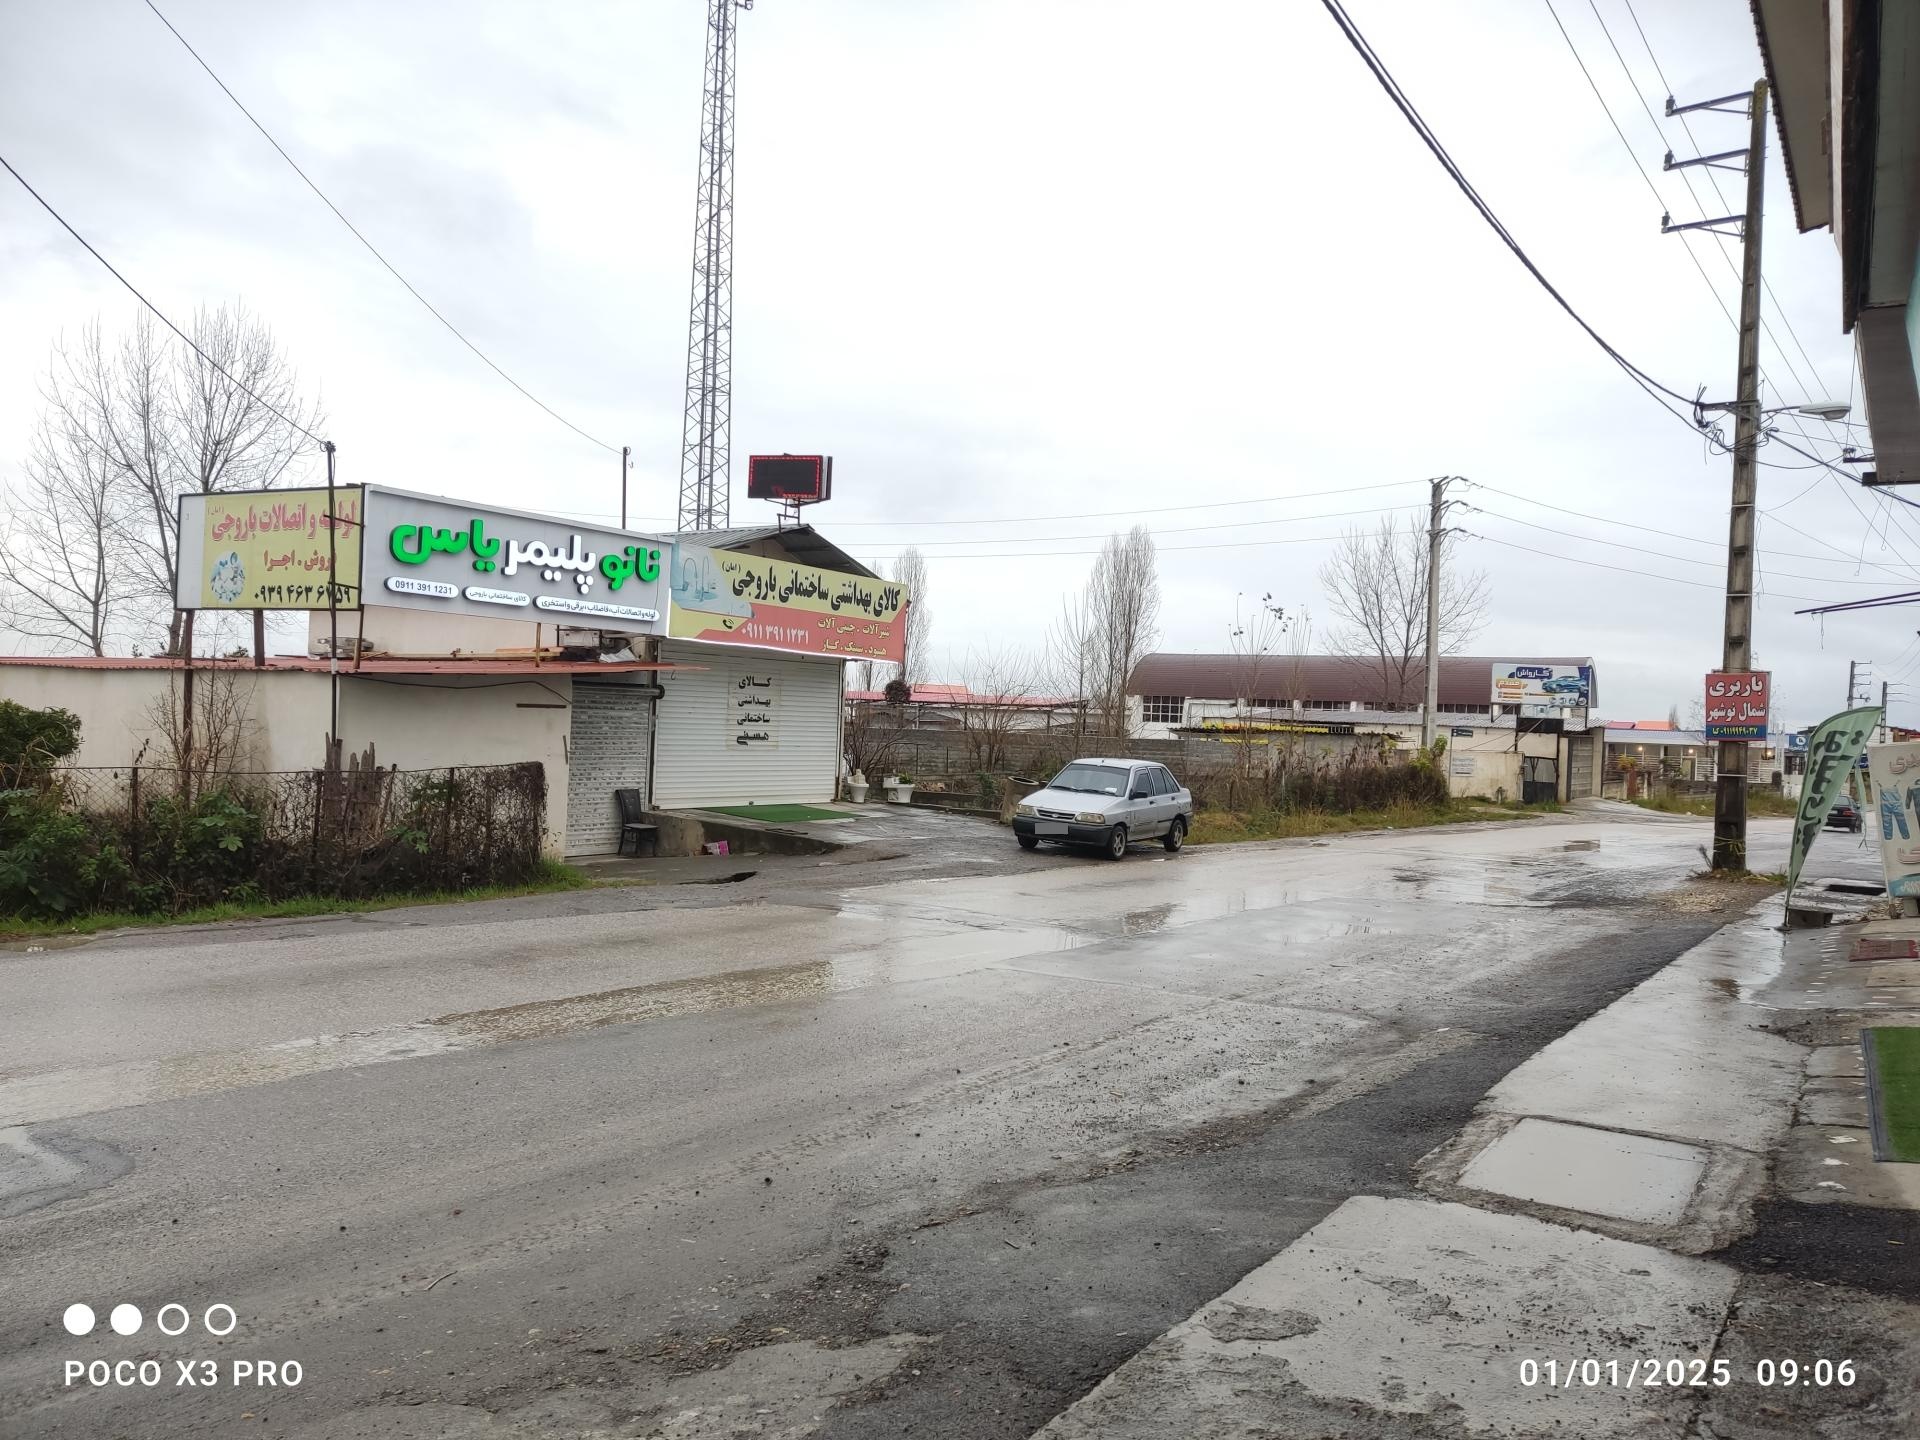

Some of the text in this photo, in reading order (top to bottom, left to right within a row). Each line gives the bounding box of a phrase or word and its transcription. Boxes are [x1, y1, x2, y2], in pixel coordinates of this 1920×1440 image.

[259, 502, 306, 532] اتصالات
[307, 513, 316, 539] و
[264, 549, 295, 571] اجرا
[389, 518, 661, 595] نانو پلیمر یاس
[254, 585, 283, 603] ۰۹۳۹
[287, 585, 313, 603] ۴۶۳
[395, 580, 452, 595] 0911 391 1231
[733, 565, 777, 601] باروجی
[778, 568, 829, 603] ساختمانی
[831, 581, 872, 614] بهداشتی
[874, 585, 901, 617] کالای
[741, 622, 809, 645] ۰۹۱۱ ۳۹۱ ۱۲۳۱
[817, 617, 836, 628] آلات
[738, 675, 772, 689] کالای
[1517, 669, 1550, 678] کارواش
[1709, 675, 1763, 697] باربری
[737, 695, 771, 708] بهداشتی
[1706, 702, 1766, 721] شمال نوشهر
[736, 712, 770, 725] ساختمانی
